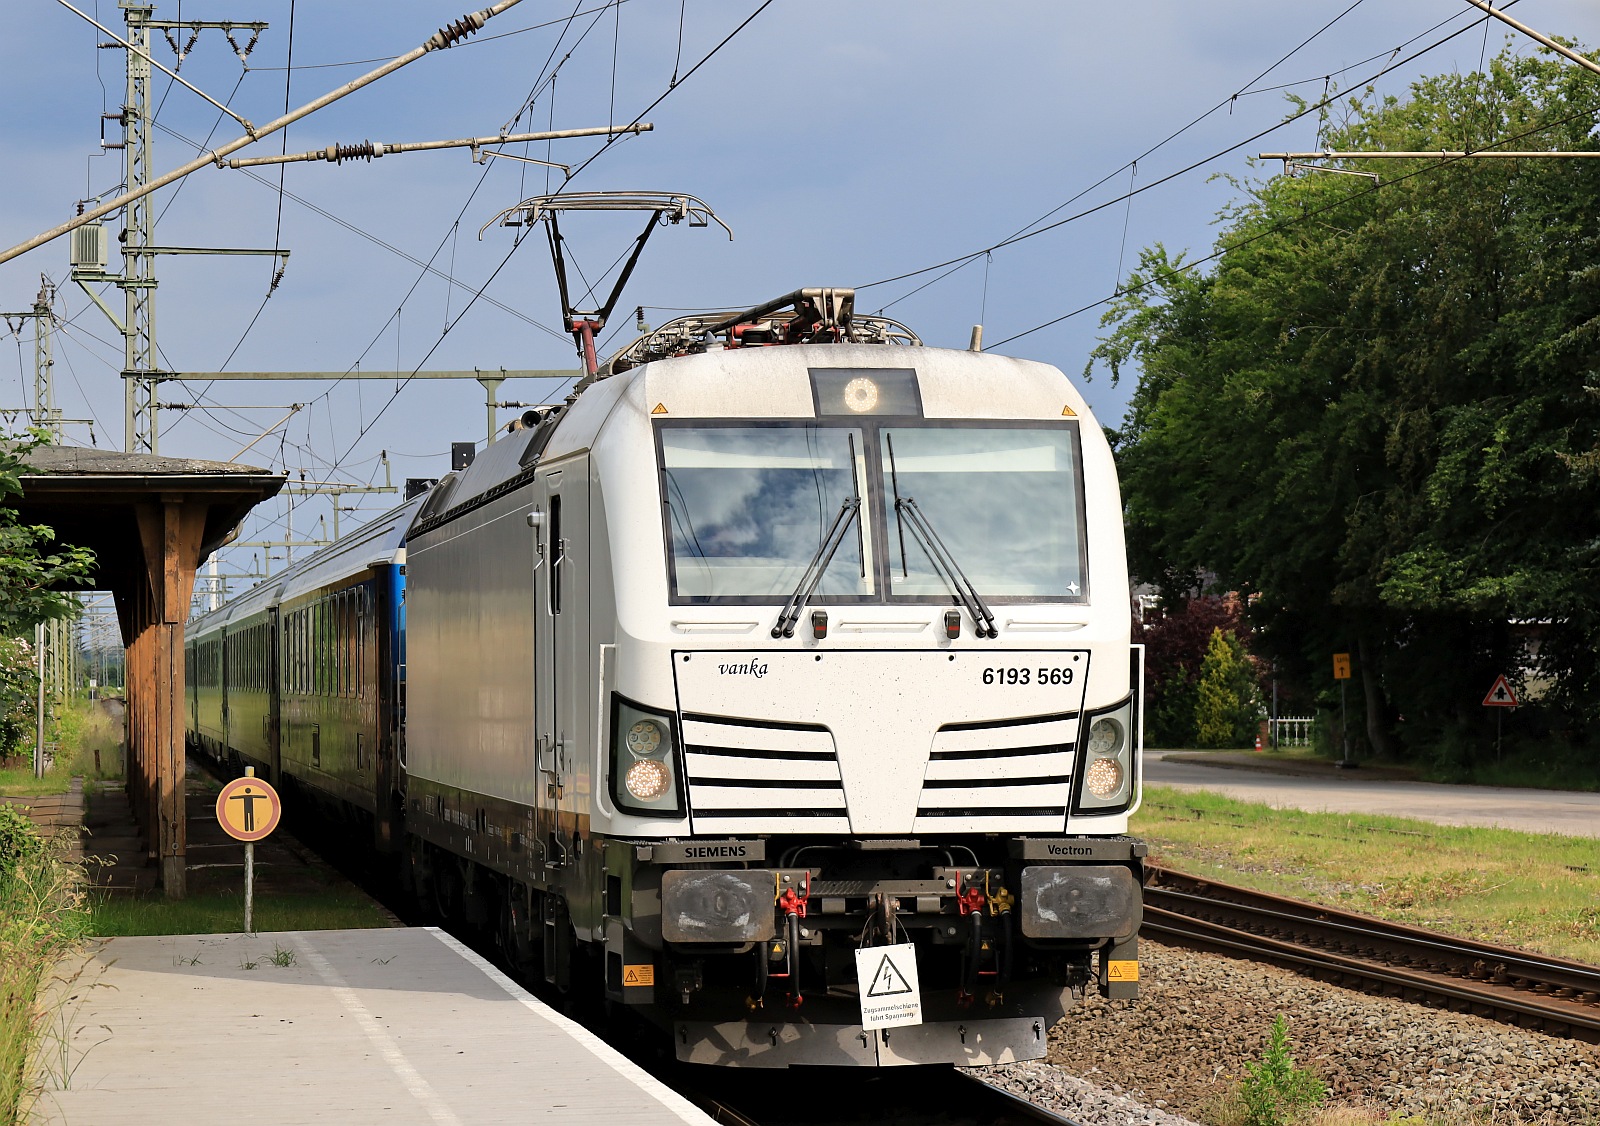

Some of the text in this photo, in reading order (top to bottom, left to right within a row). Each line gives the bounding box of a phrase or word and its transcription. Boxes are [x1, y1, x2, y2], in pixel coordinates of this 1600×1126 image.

[718, 657, 769, 679] vanka
[982, 668, 1074, 686] 6193 569
[685, 846, 746, 858] SIEMENS
[1048, 845, 1093, 856] Vectron
[863, 1002, 919, 1014] Zugsammelschiene
